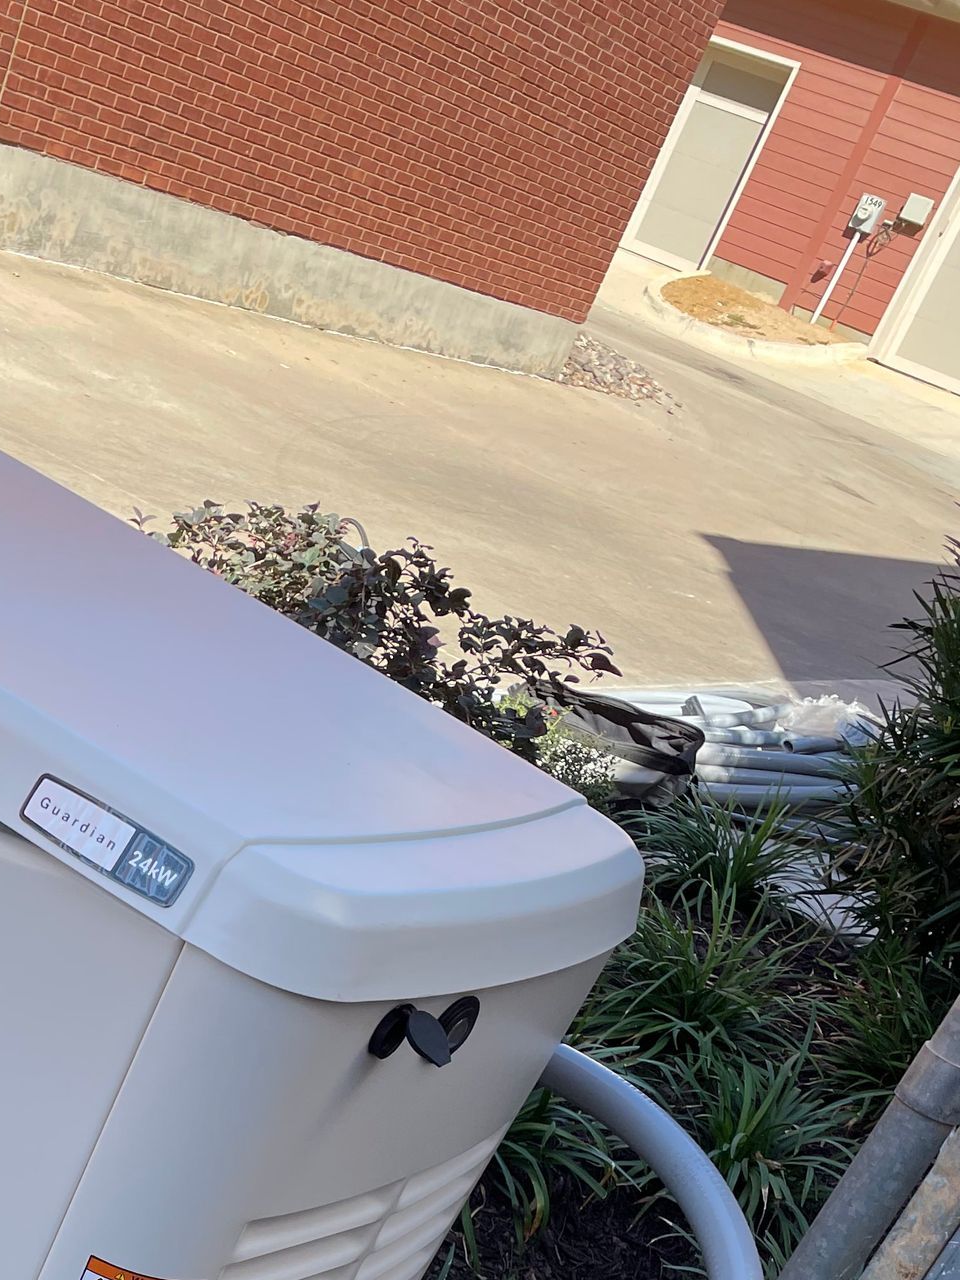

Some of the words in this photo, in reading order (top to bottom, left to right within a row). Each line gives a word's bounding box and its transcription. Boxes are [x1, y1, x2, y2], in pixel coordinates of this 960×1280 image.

[864, 196, 882, 208] 1549
[40, 797, 117, 851] Guardian
[128, 850, 178, 887] 24kW
